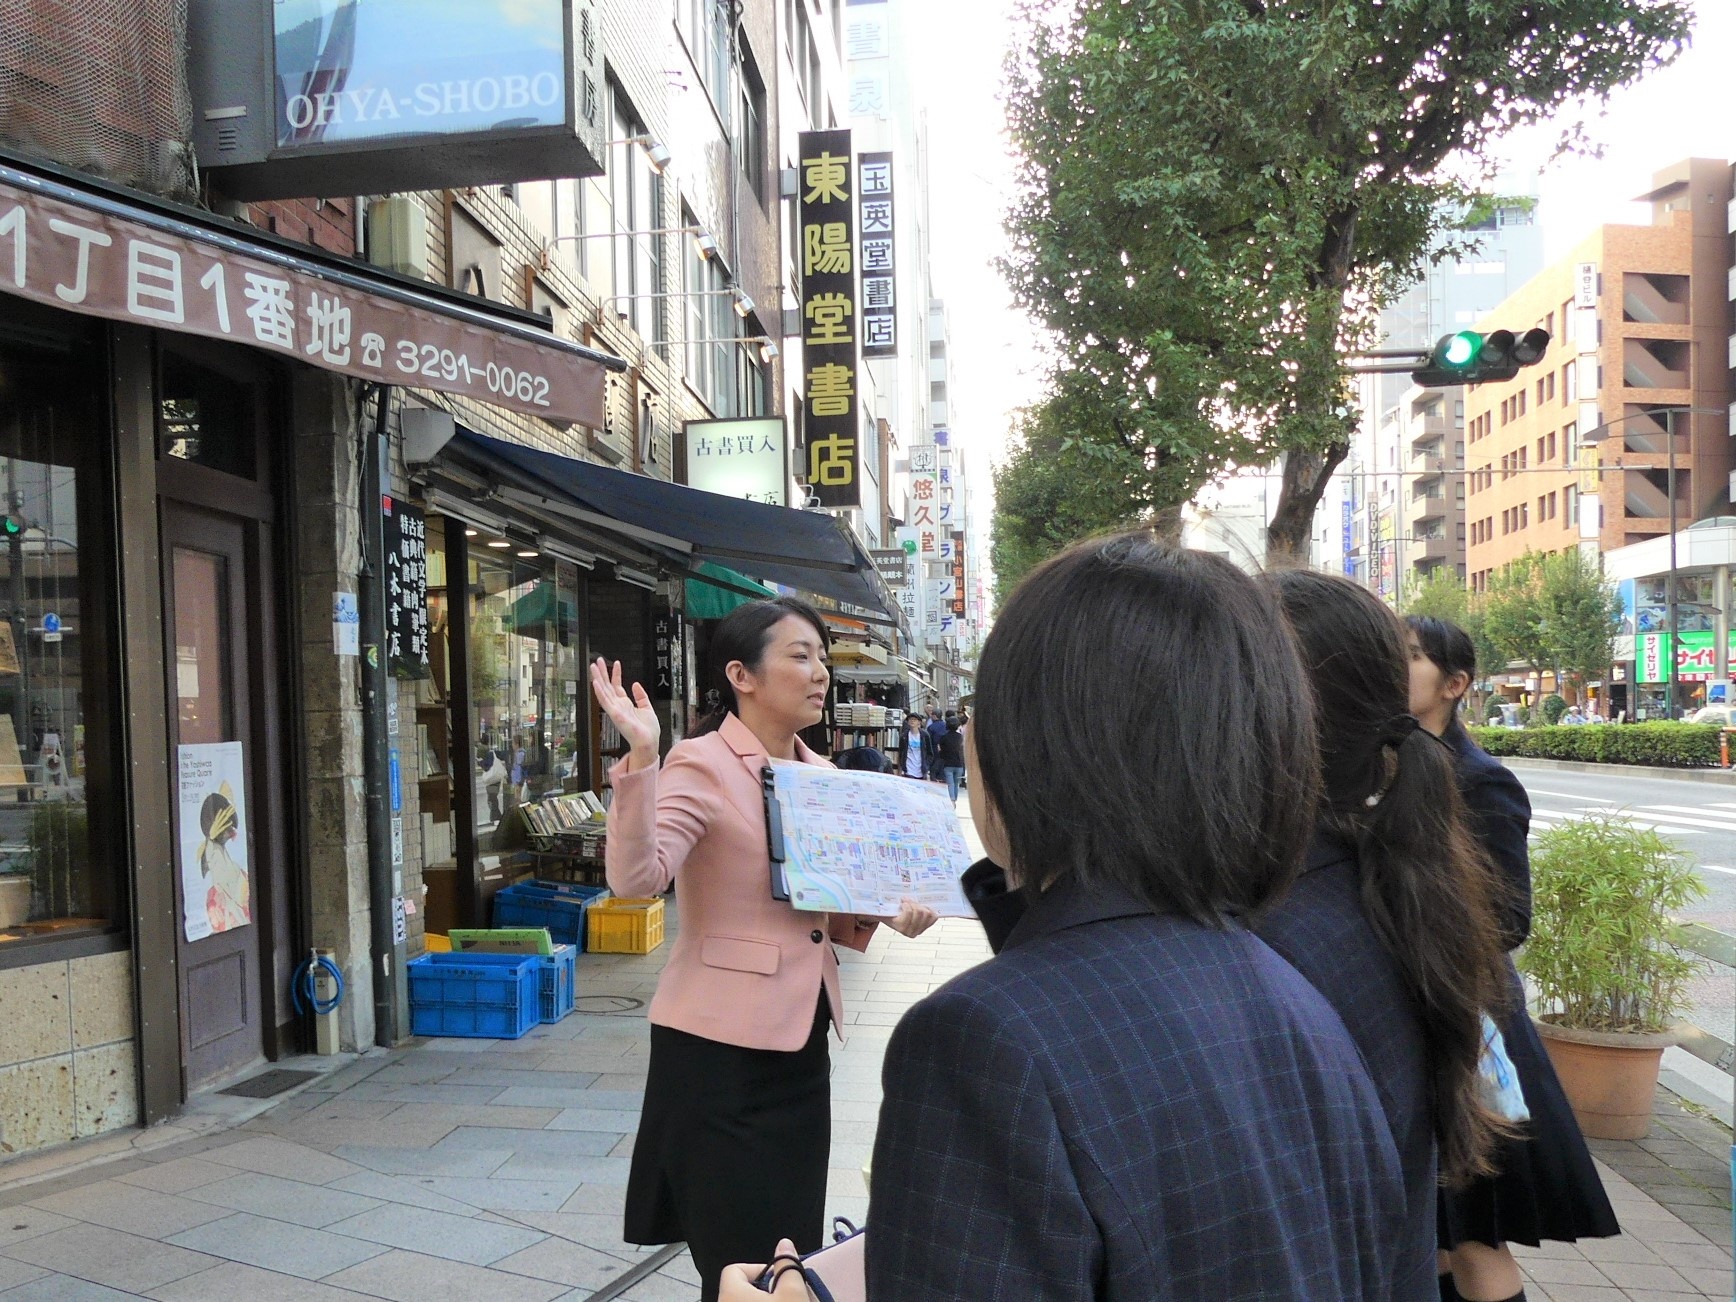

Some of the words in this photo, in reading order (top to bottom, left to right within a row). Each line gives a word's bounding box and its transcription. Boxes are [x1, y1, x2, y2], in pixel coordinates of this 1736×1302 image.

[286, 72, 560, 130] OHYA-SHOBO
[863, 163, 893, 346] 玉英堂書店
[802, 151, 854, 487] 東陽堂書店
[396, 338, 551, 408] 3291-0062
[694, 434, 777, 457] 古書買入
[912, 479, 936, 553] 悠久堂
[388, 552, 402, 658] 八木書店
[655, 620, 670, 687] 古書買入
[1646, 636, 1657, 680] サイゼリヤ
